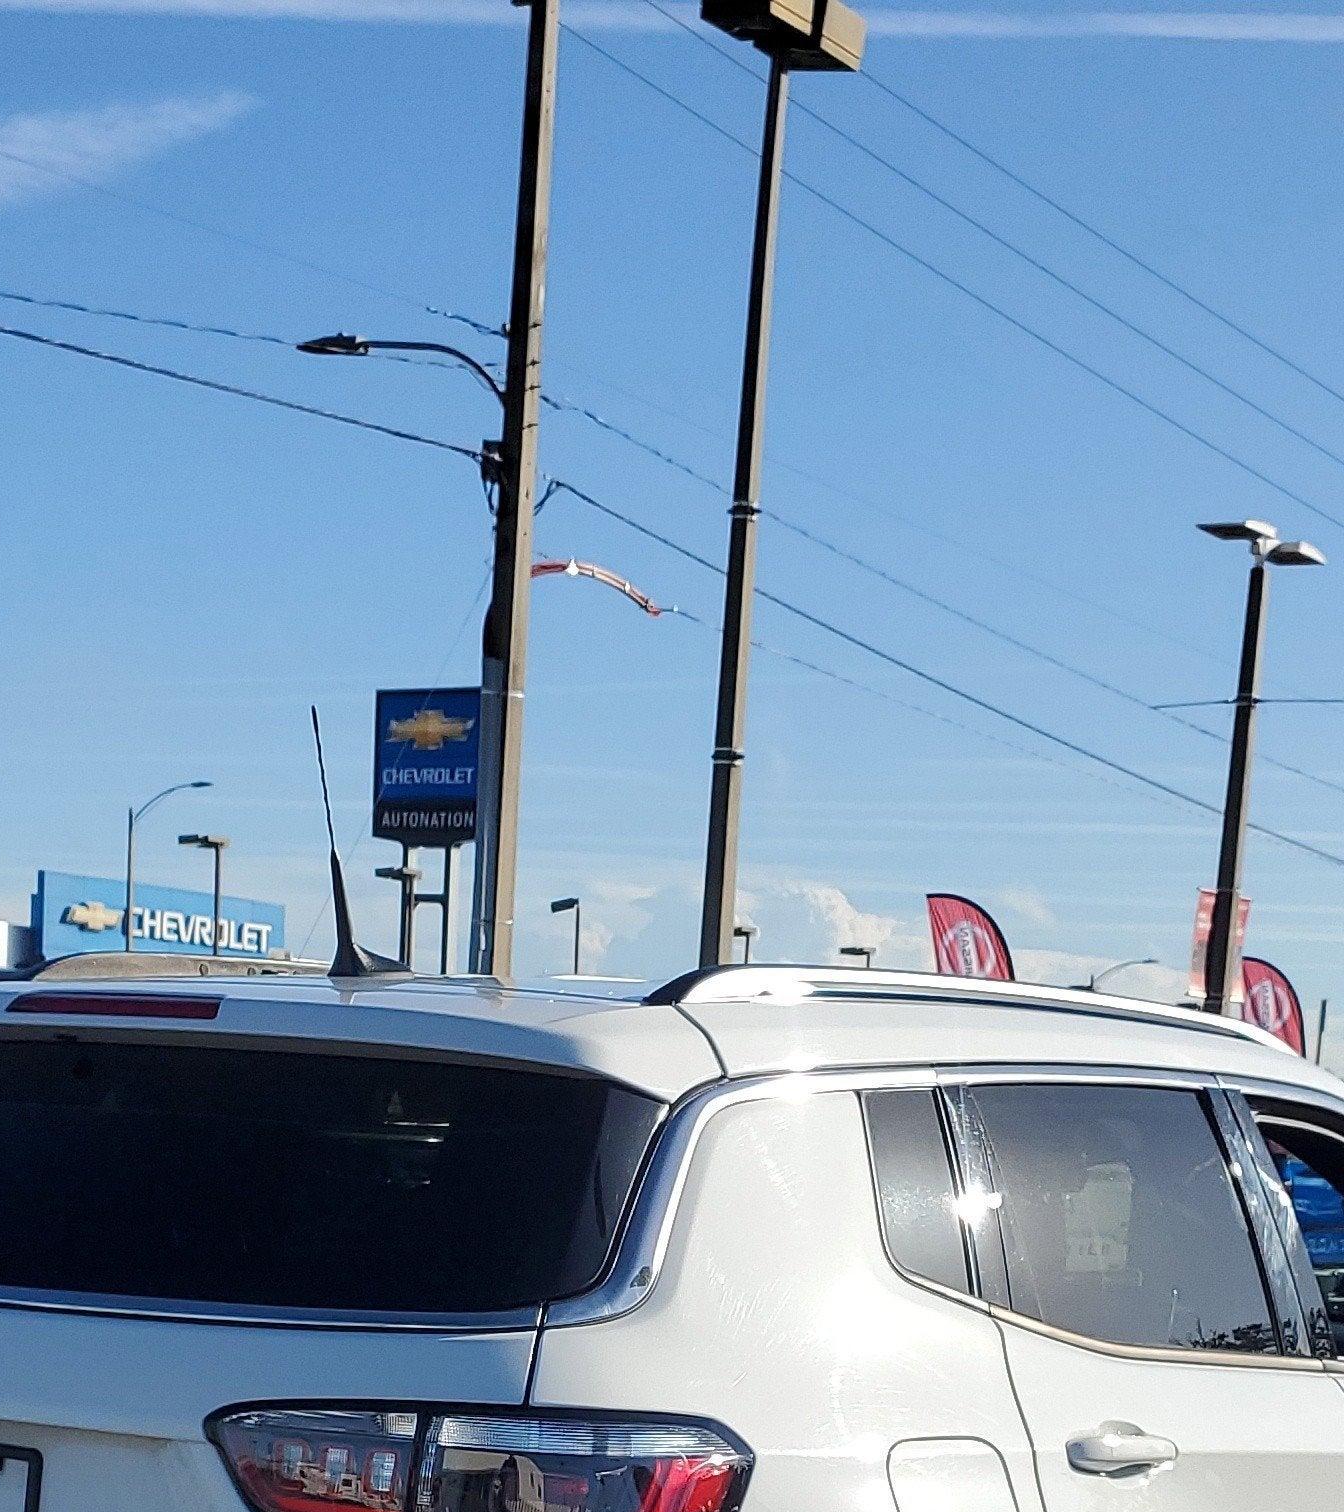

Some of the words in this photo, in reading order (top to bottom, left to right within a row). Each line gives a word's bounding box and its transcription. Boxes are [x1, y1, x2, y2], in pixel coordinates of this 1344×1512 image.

[382, 766, 475, 785] CHEVROLET
[381, 810, 475, 829] AUTONATION
[129, 906, 273, 953] CHEVROLET
